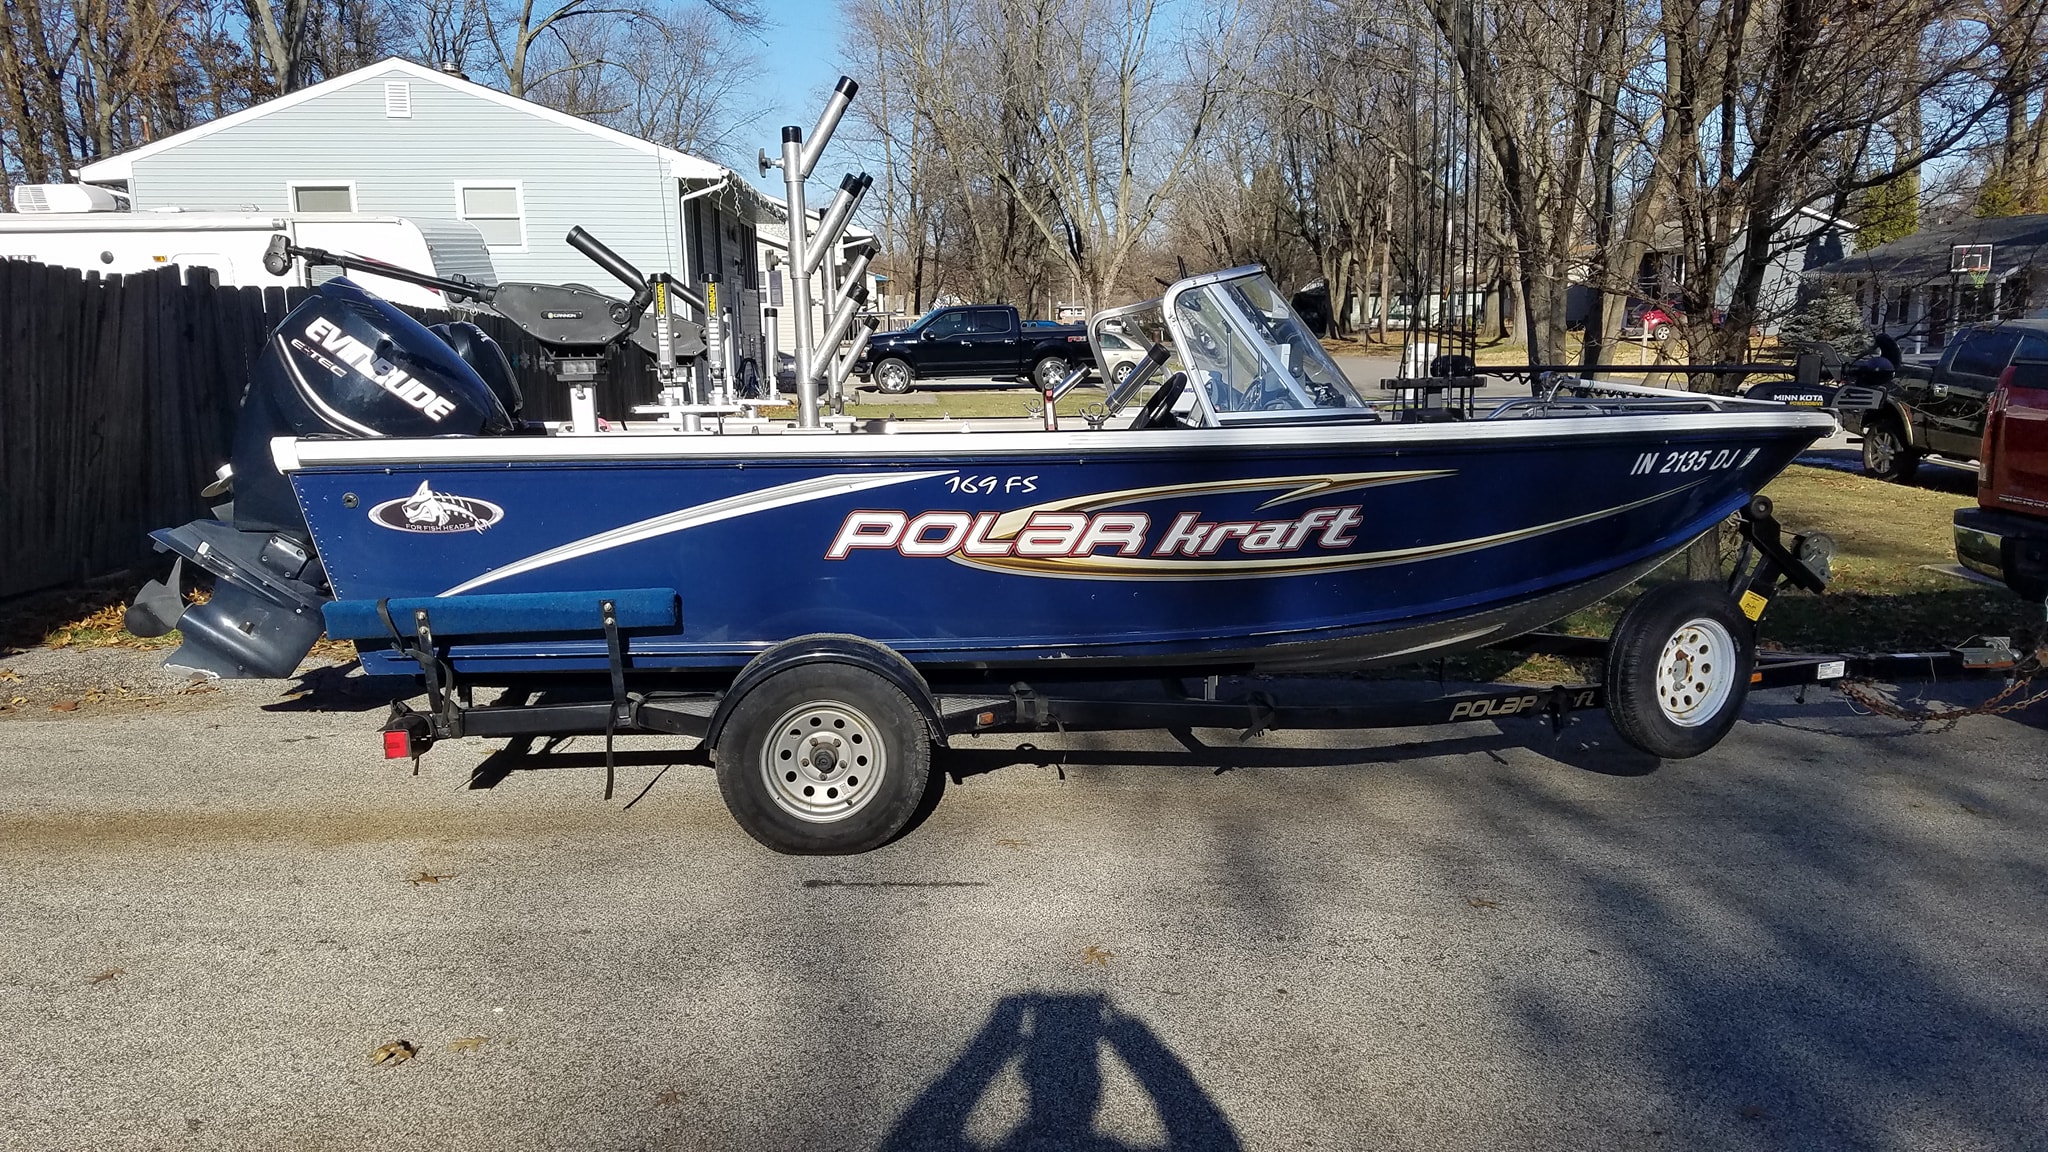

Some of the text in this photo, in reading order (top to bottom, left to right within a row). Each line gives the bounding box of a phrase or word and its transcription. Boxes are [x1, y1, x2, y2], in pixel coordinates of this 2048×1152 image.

[290, 338, 348, 378] E-TEC
[304, 316, 458, 423] EVINRUDE
[1799, 394, 1824, 402] KOTA
[1630, 449, 1742, 476] IN 2135 DJ
[944, 475, 1039, 495] 169 FS
[443, 522, 470, 531] HEADS
[823, 504, 1364, 560] POLAR kraft
